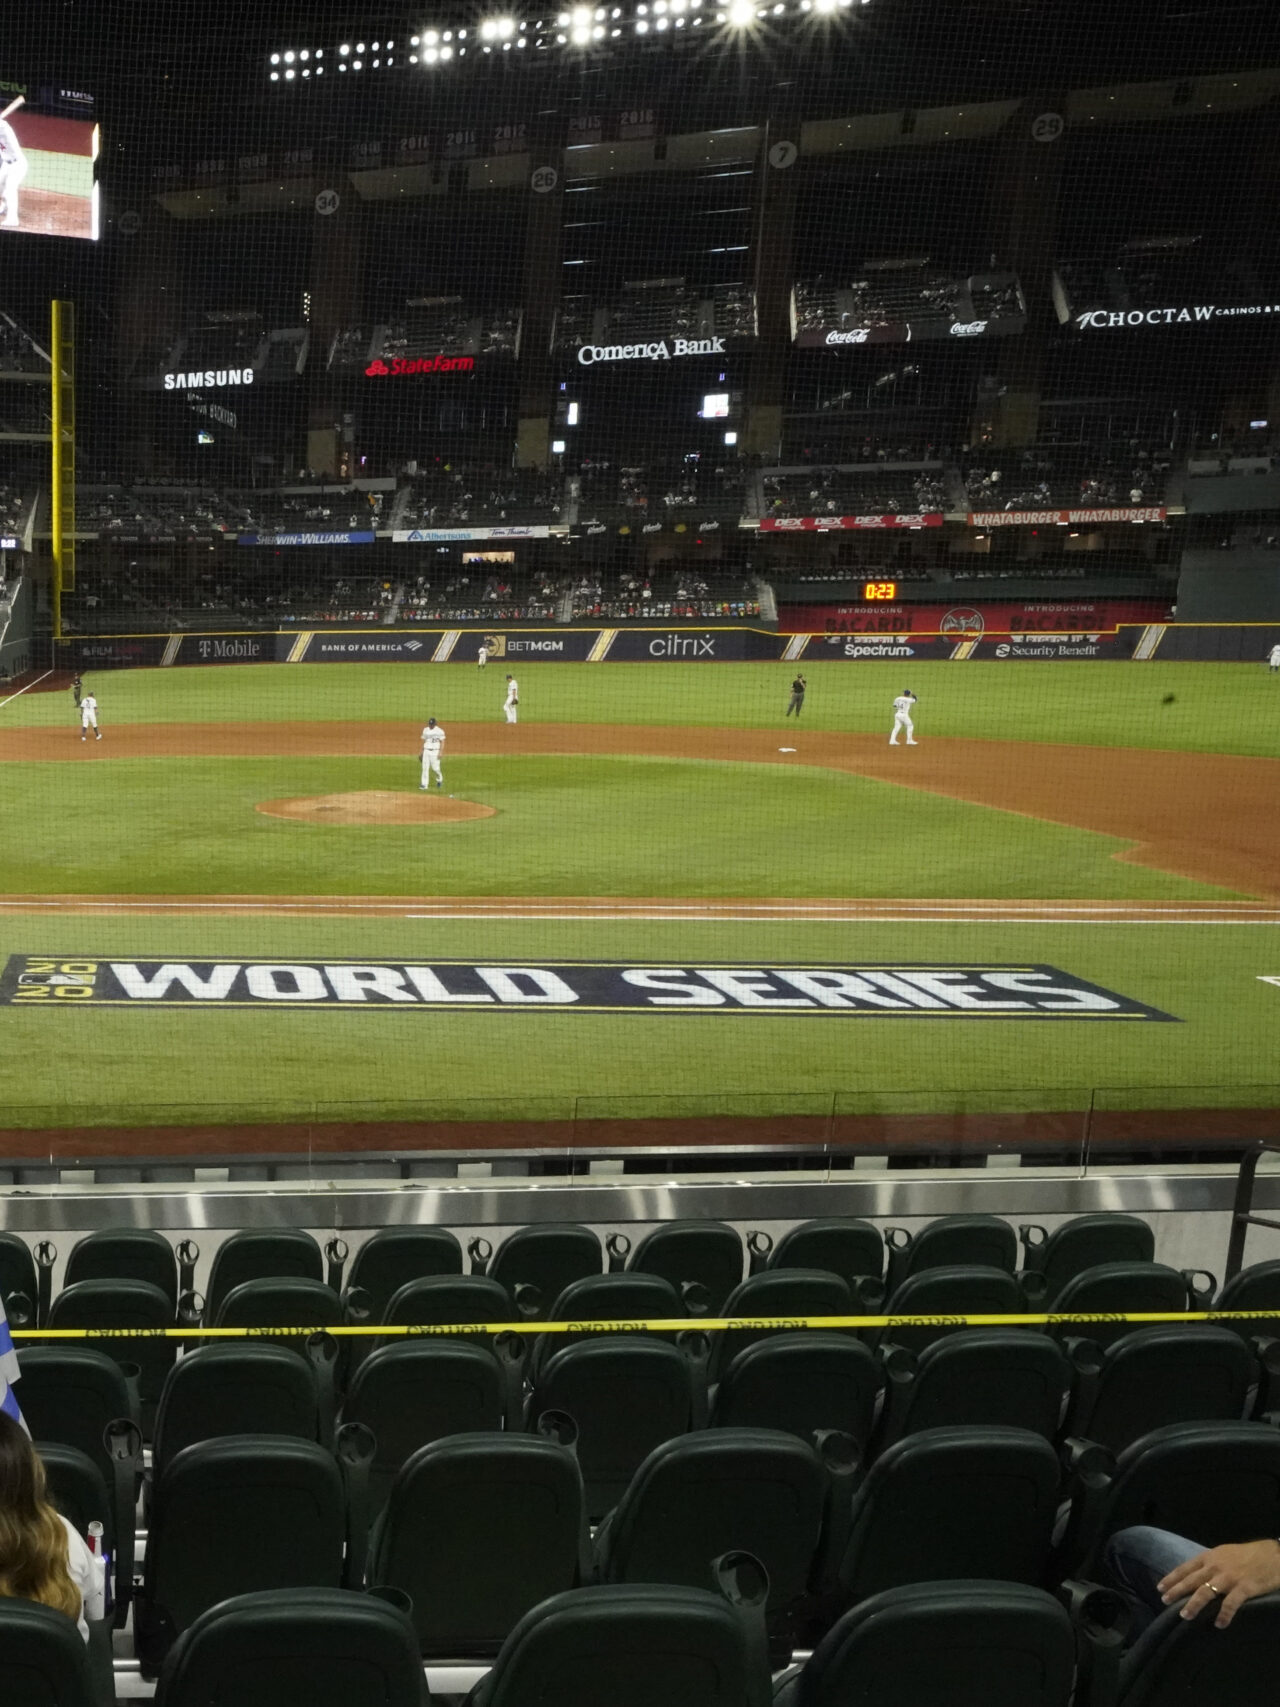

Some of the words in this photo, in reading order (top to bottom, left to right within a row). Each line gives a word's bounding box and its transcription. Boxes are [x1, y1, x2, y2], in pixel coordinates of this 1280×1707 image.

[778, 146, 789, 163] 7
[534, 171, 554, 187] 26
[318, 194, 337, 210] 34
[1089, 305, 1215, 328] CHOCTAW
[1215, 306, 1261, 316] CASINOS
[673, 336, 726, 357] Bank
[164, 368, 254, 390] SAMSUNG
[774, 518, 804, 527] DEX
[814, 517, 843, 525] DEX
[854, 515, 884, 524] DEX
[895, 514, 925, 523] DEX
[972, 511, 1061, 526] WHATABURGER
[1069, 509, 1161, 523] WHATABURGER
[424, 532, 471, 541] Albertsons
[488, 528, 507, 537] Tom
[508, 527, 533, 536] Thumb
[865, 583, 895, 599] 0:23
[321, 643, 346, 652] BANK
[348, 643, 360, 651] OF
[362, 643, 403, 652] AMERICA
[507, 640, 564, 652] BETMGM
[649, 633, 716, 656] citrix
[844, 643, 910, 658] Spectrum
[1011, 645, 1055, 658] Security
[1058, 644, 1096, 656] Benefit
[25, 962, 98, 974] 20
[14, 985, 94, 998] 20
[109, 963, 580, 1003] WORLD
[620, 968, 1120, 1010] SERIES
